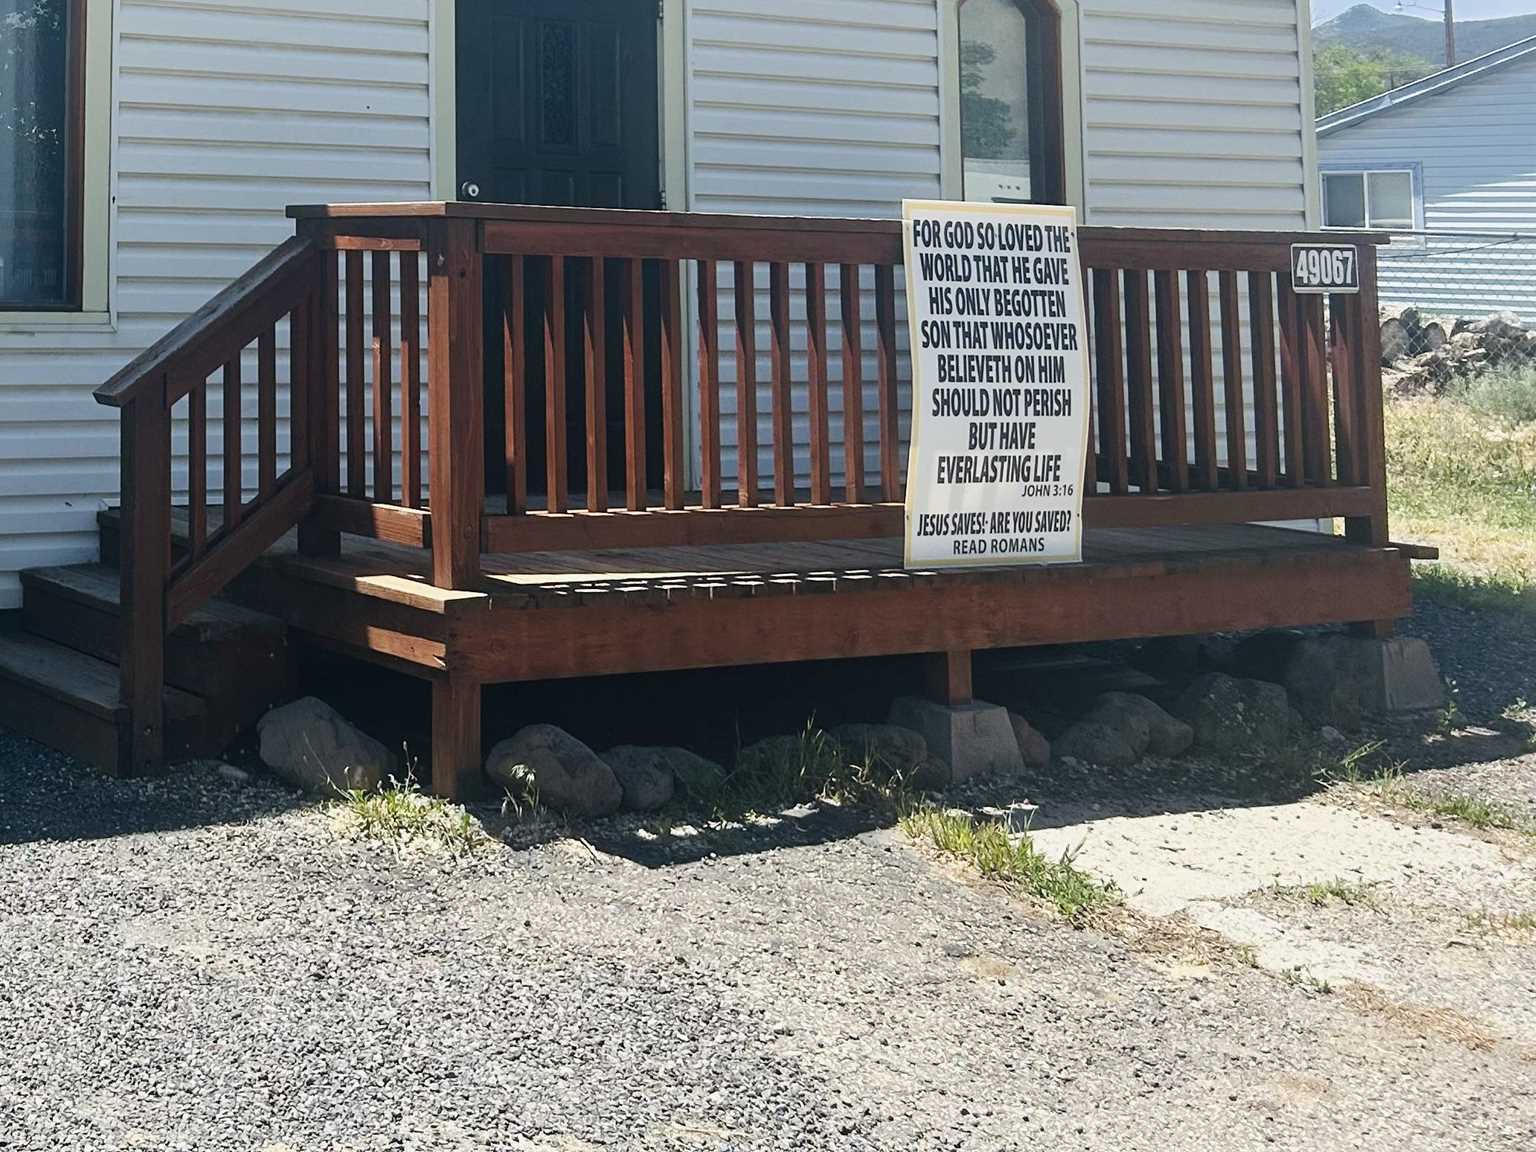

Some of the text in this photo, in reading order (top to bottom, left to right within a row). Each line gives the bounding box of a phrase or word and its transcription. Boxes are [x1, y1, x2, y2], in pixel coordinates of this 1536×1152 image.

[914, 219, 1071, 253] FOR GOD SO LOVED THE
[919, 253, 1069, 285] WORLD THAT HE GAVE
[1296, 249, 1353, 285] 49067
[929, 287, 1066, 317] HIS ONLY BEGOTTEN
[921, 320, 1078, 350] SON THAT WHOSOEVER
[938, 354, 1065, 383] BELIEVETH ON HIM
[932, 388, 1072, 417] SHOULD NOT PERISH
[968, 422, 1036, 450] BUT HAVE
[937, 454, 1062, 484] EVERLASTING LIFE
[1022, 484, 1074, 497] JOHN 3:16
[917, 513, 950, 537] JESUS
[989, 511, 1010, 534] ARE
[1013, 511, 1035, 533] YOU
[1035, 510, 1072, 533] SAVED?
[953, 537, 1045, 555] READ ROMANS
